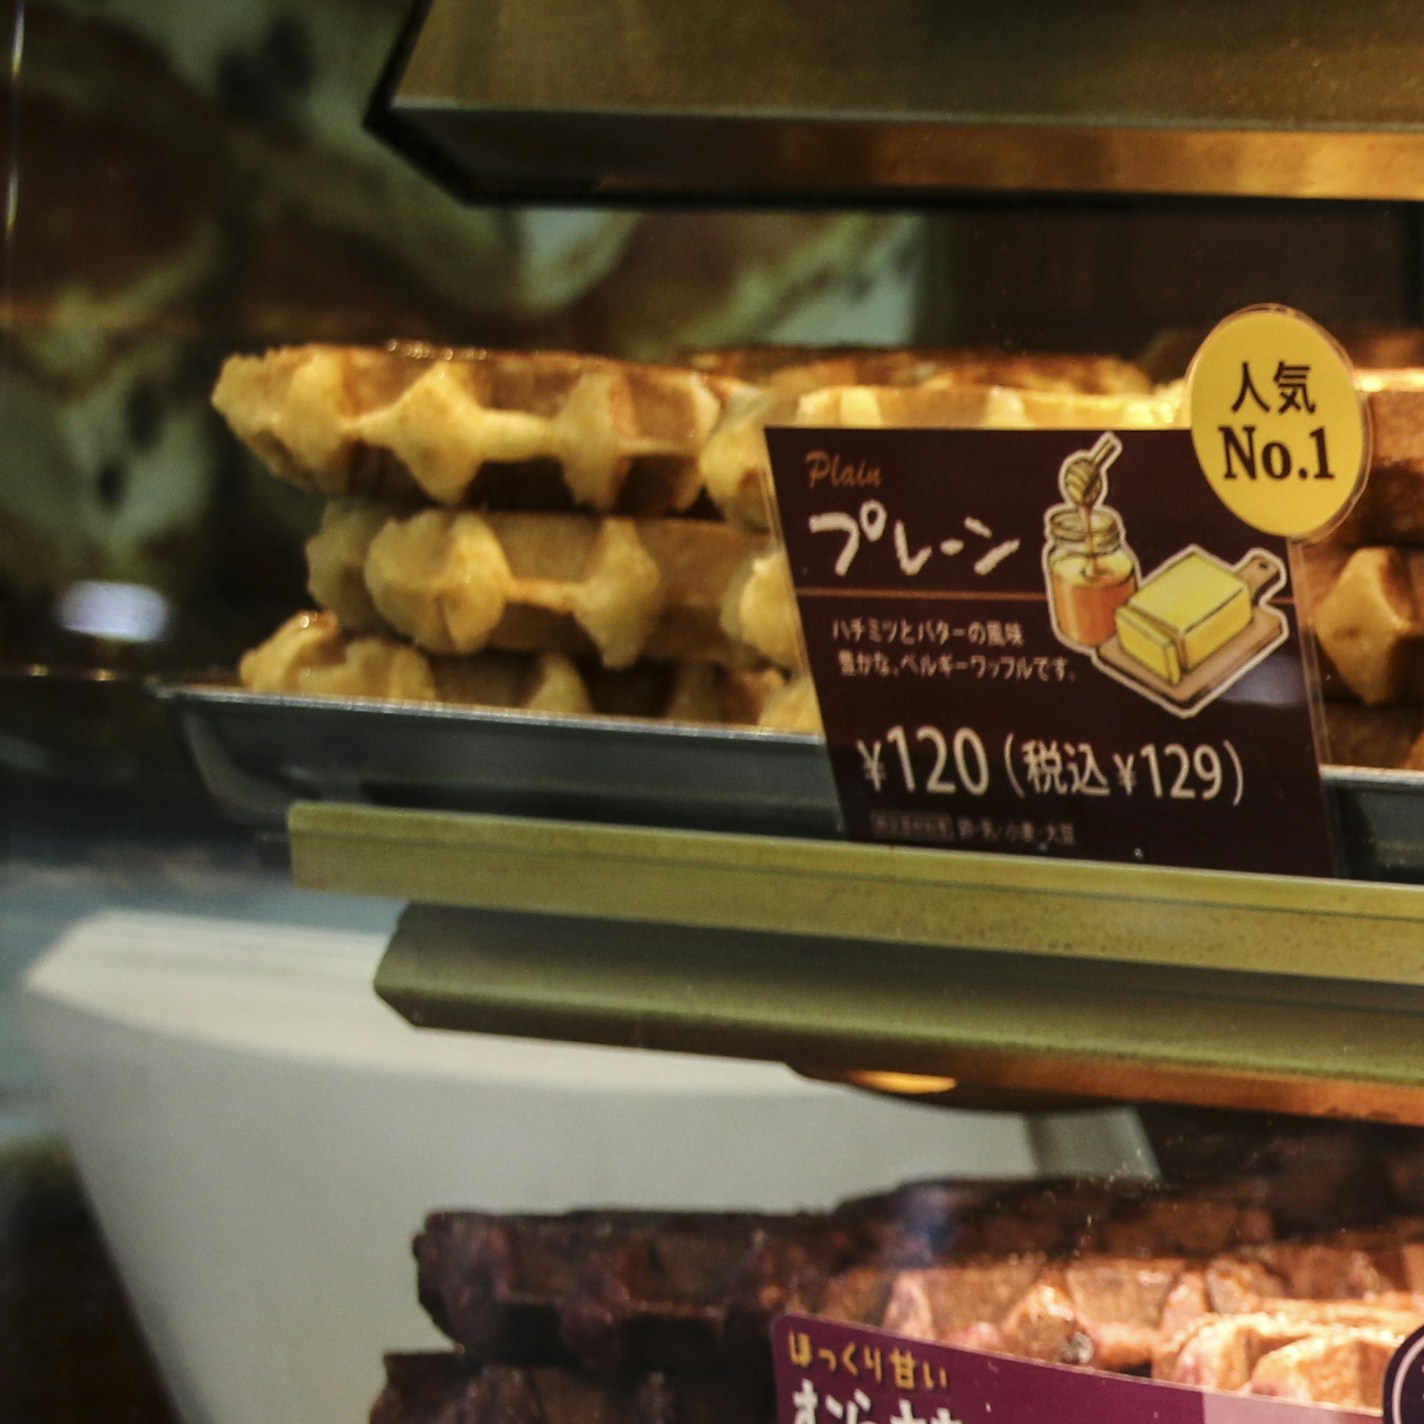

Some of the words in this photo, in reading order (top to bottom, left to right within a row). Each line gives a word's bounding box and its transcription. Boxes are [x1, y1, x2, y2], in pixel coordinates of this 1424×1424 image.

[1231, 361, 1317, 416] 人気
[806, 450, 882, 489] Plain
[1218, 426, 1336, 481] No.1
[808, 500, 1020, 576] プレーン
[788, 1331, 947, 1389] ほっくり甘い
